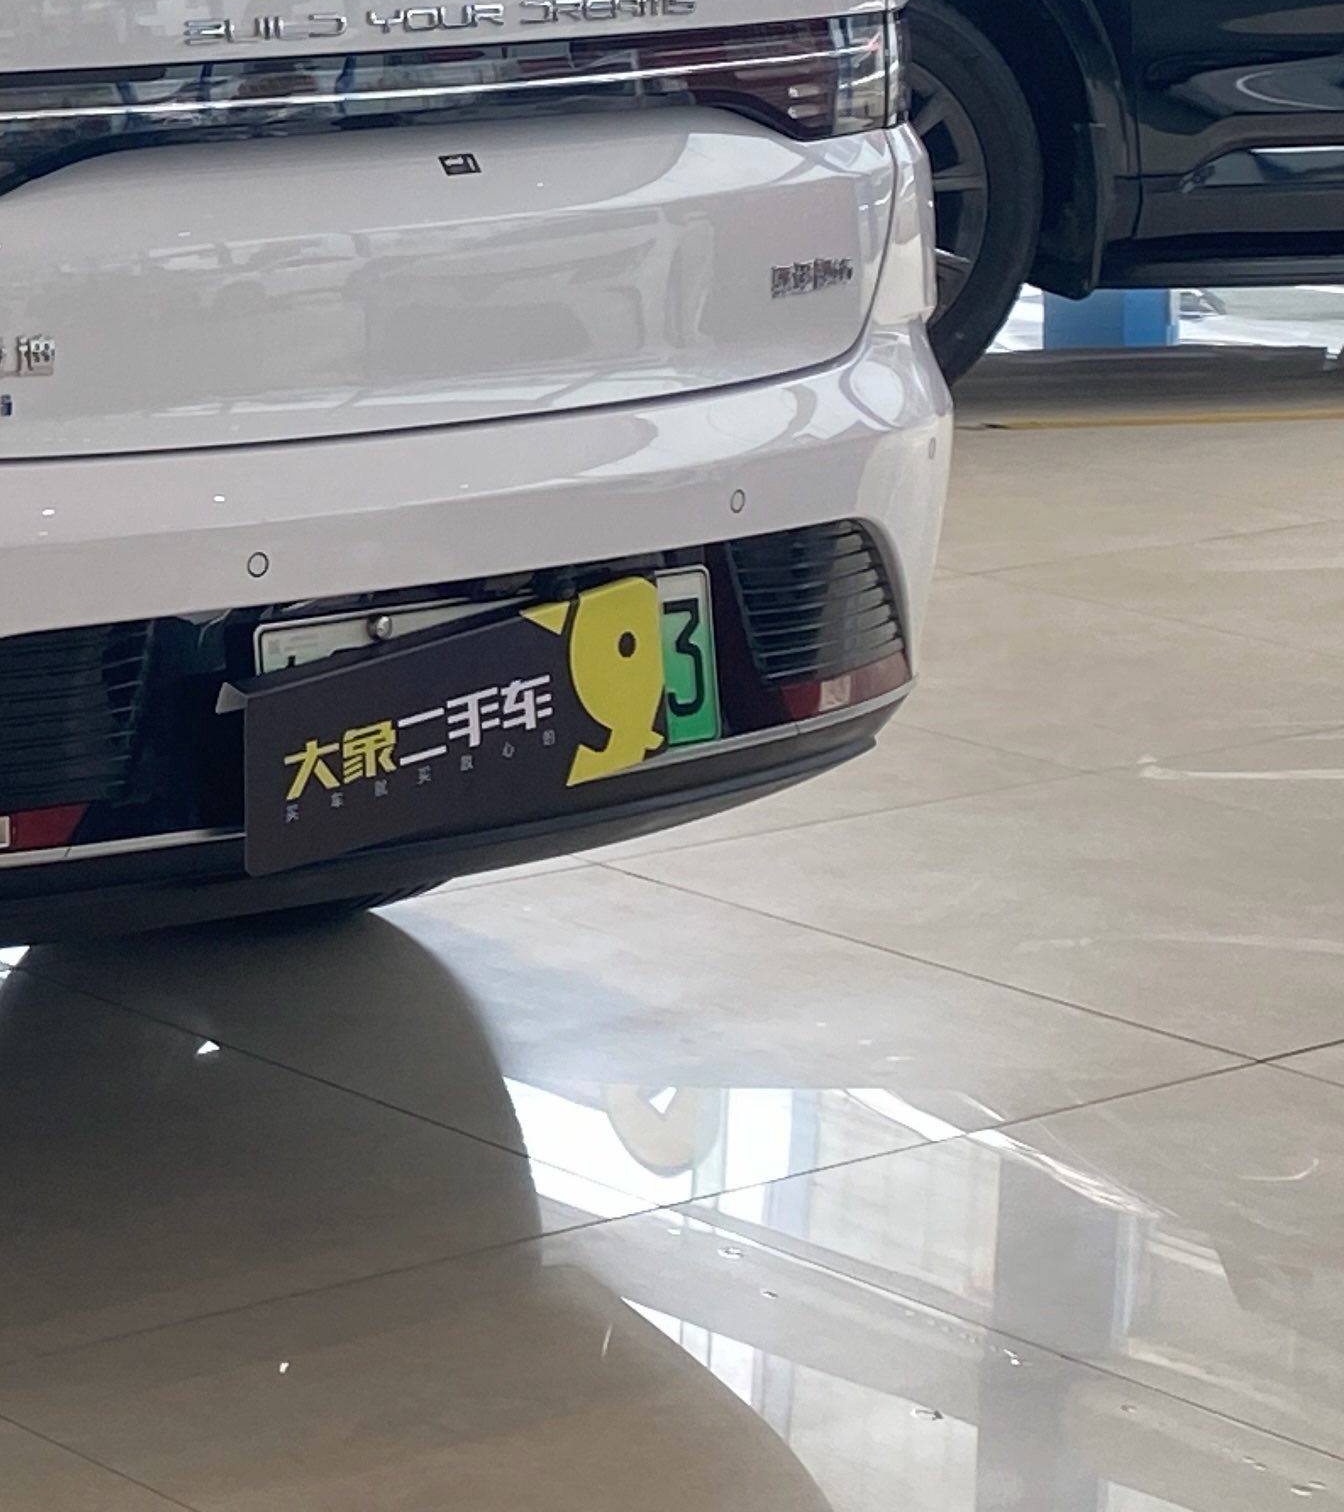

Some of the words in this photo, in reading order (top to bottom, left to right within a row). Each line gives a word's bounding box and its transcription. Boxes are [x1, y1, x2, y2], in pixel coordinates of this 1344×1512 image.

[365, 1, 505, 35] YOUR
[283, 673, 554, 802] 大象二手车
